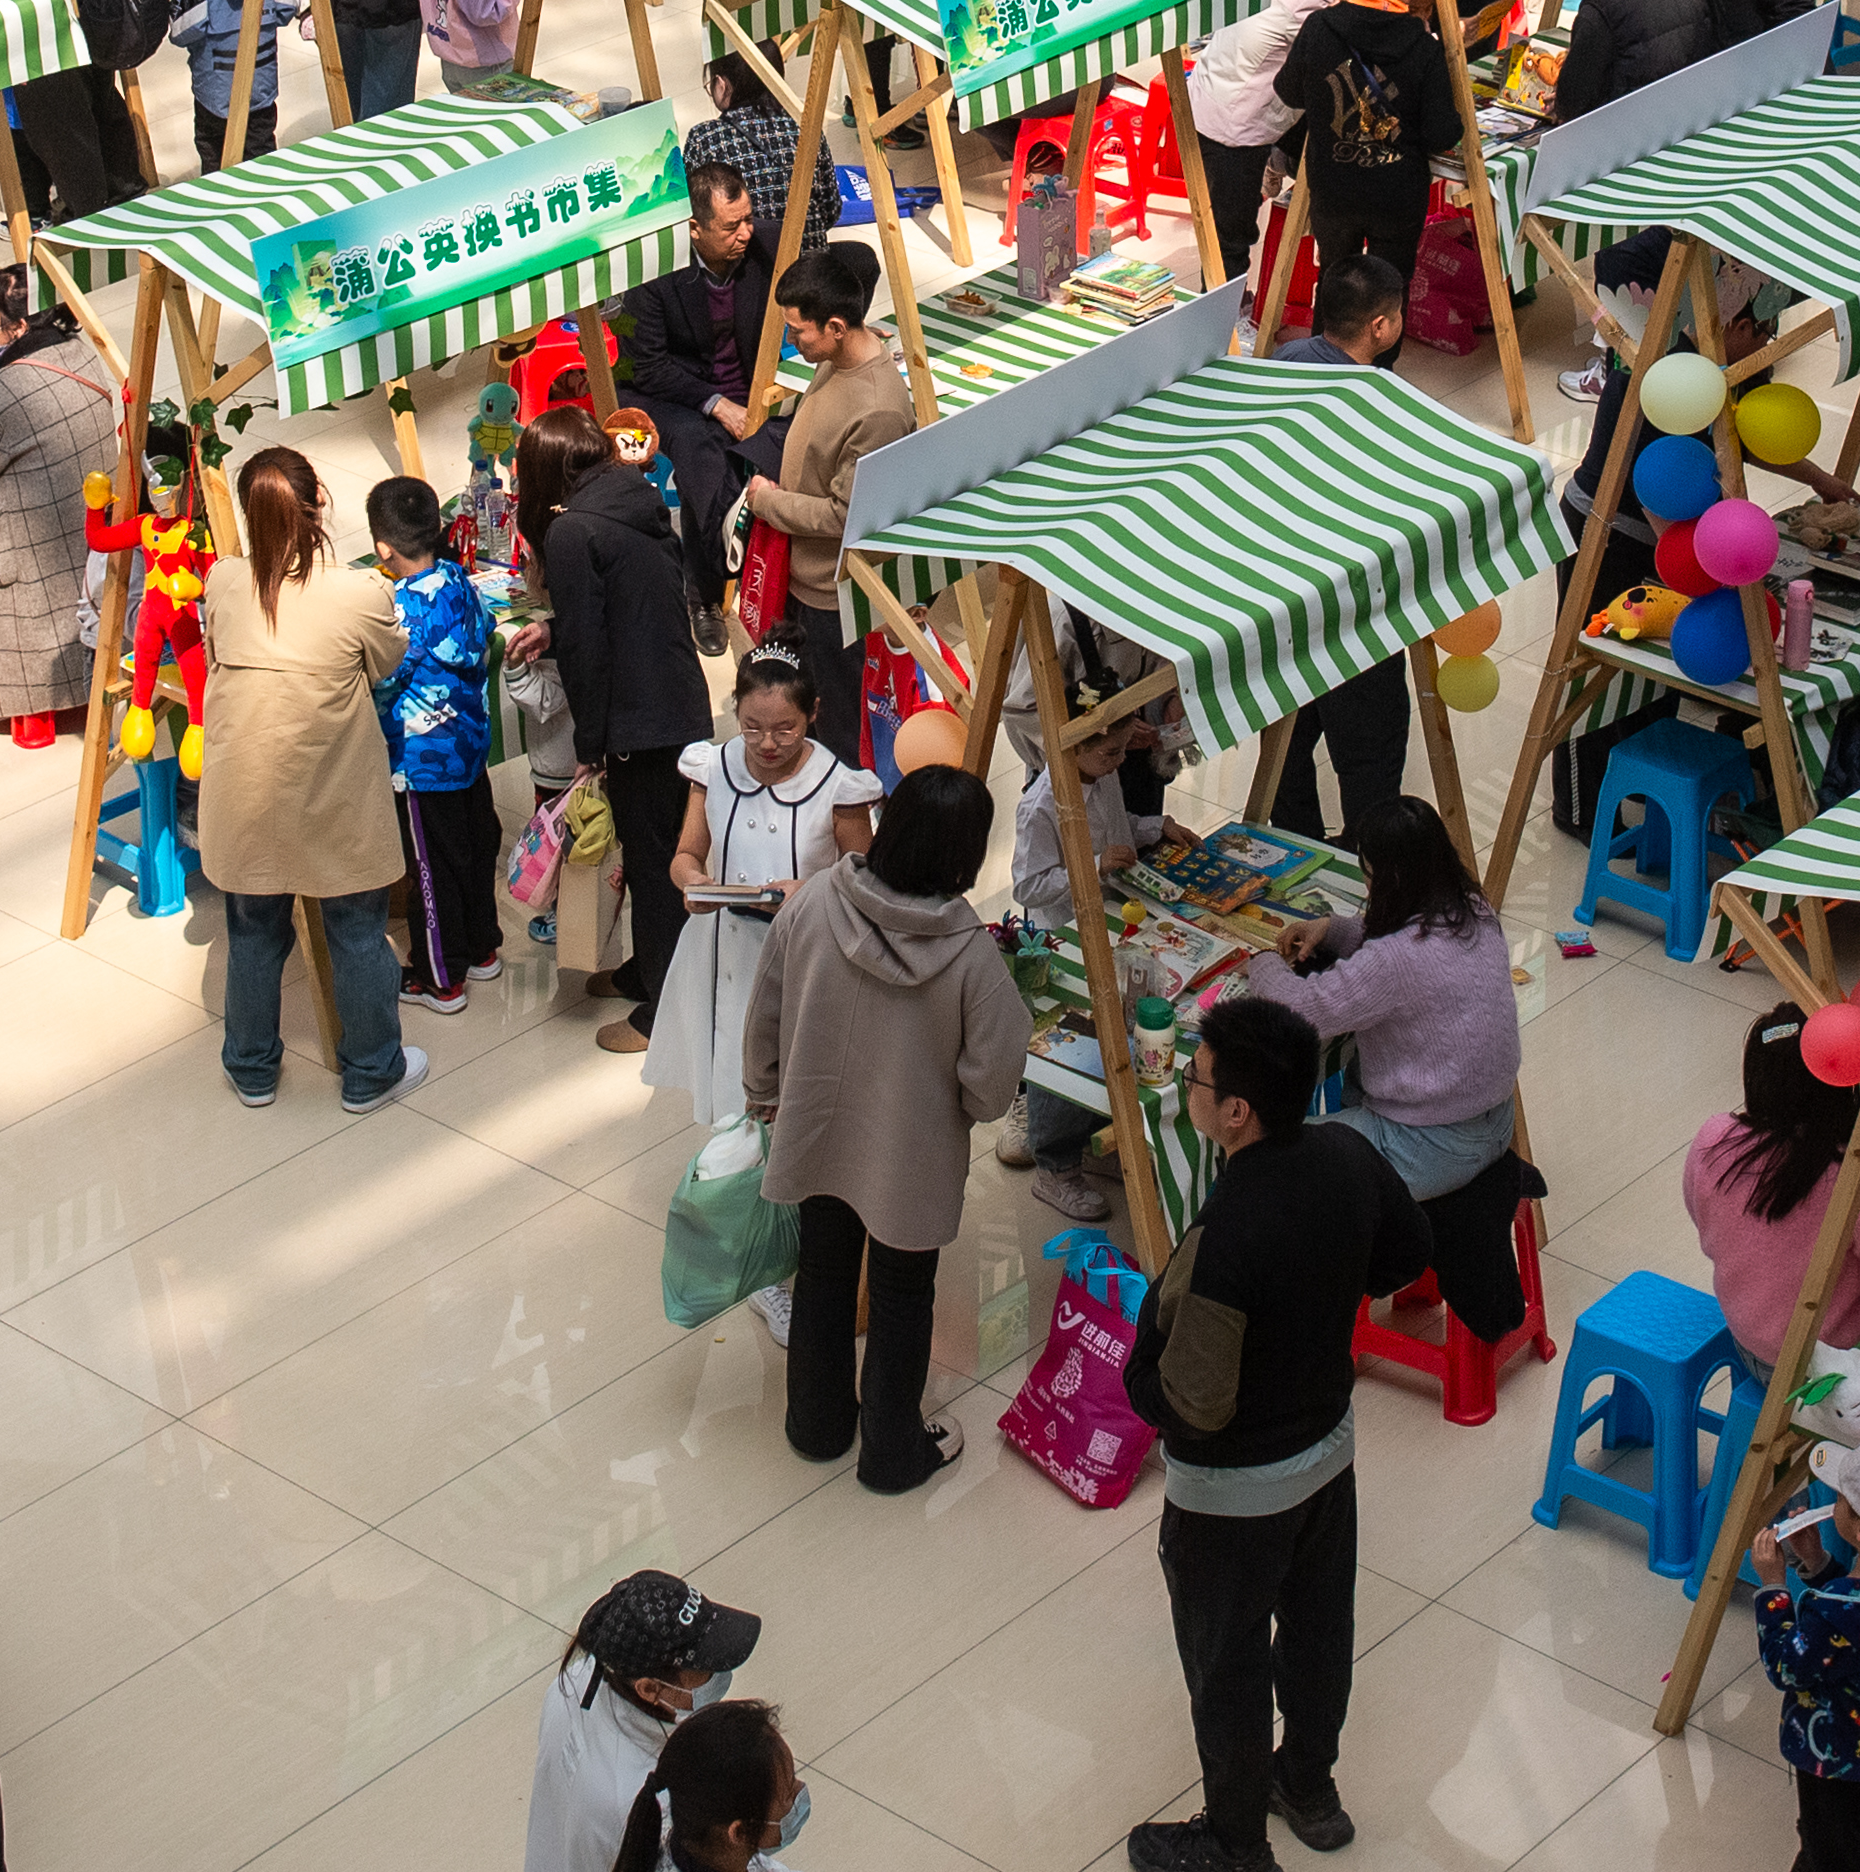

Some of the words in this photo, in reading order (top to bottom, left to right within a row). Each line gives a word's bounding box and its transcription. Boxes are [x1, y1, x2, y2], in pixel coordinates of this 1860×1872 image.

[329, 161, 624, 304] 蒲公英换书市集
[1080, 1320, 1126, 1361] 进前佳
